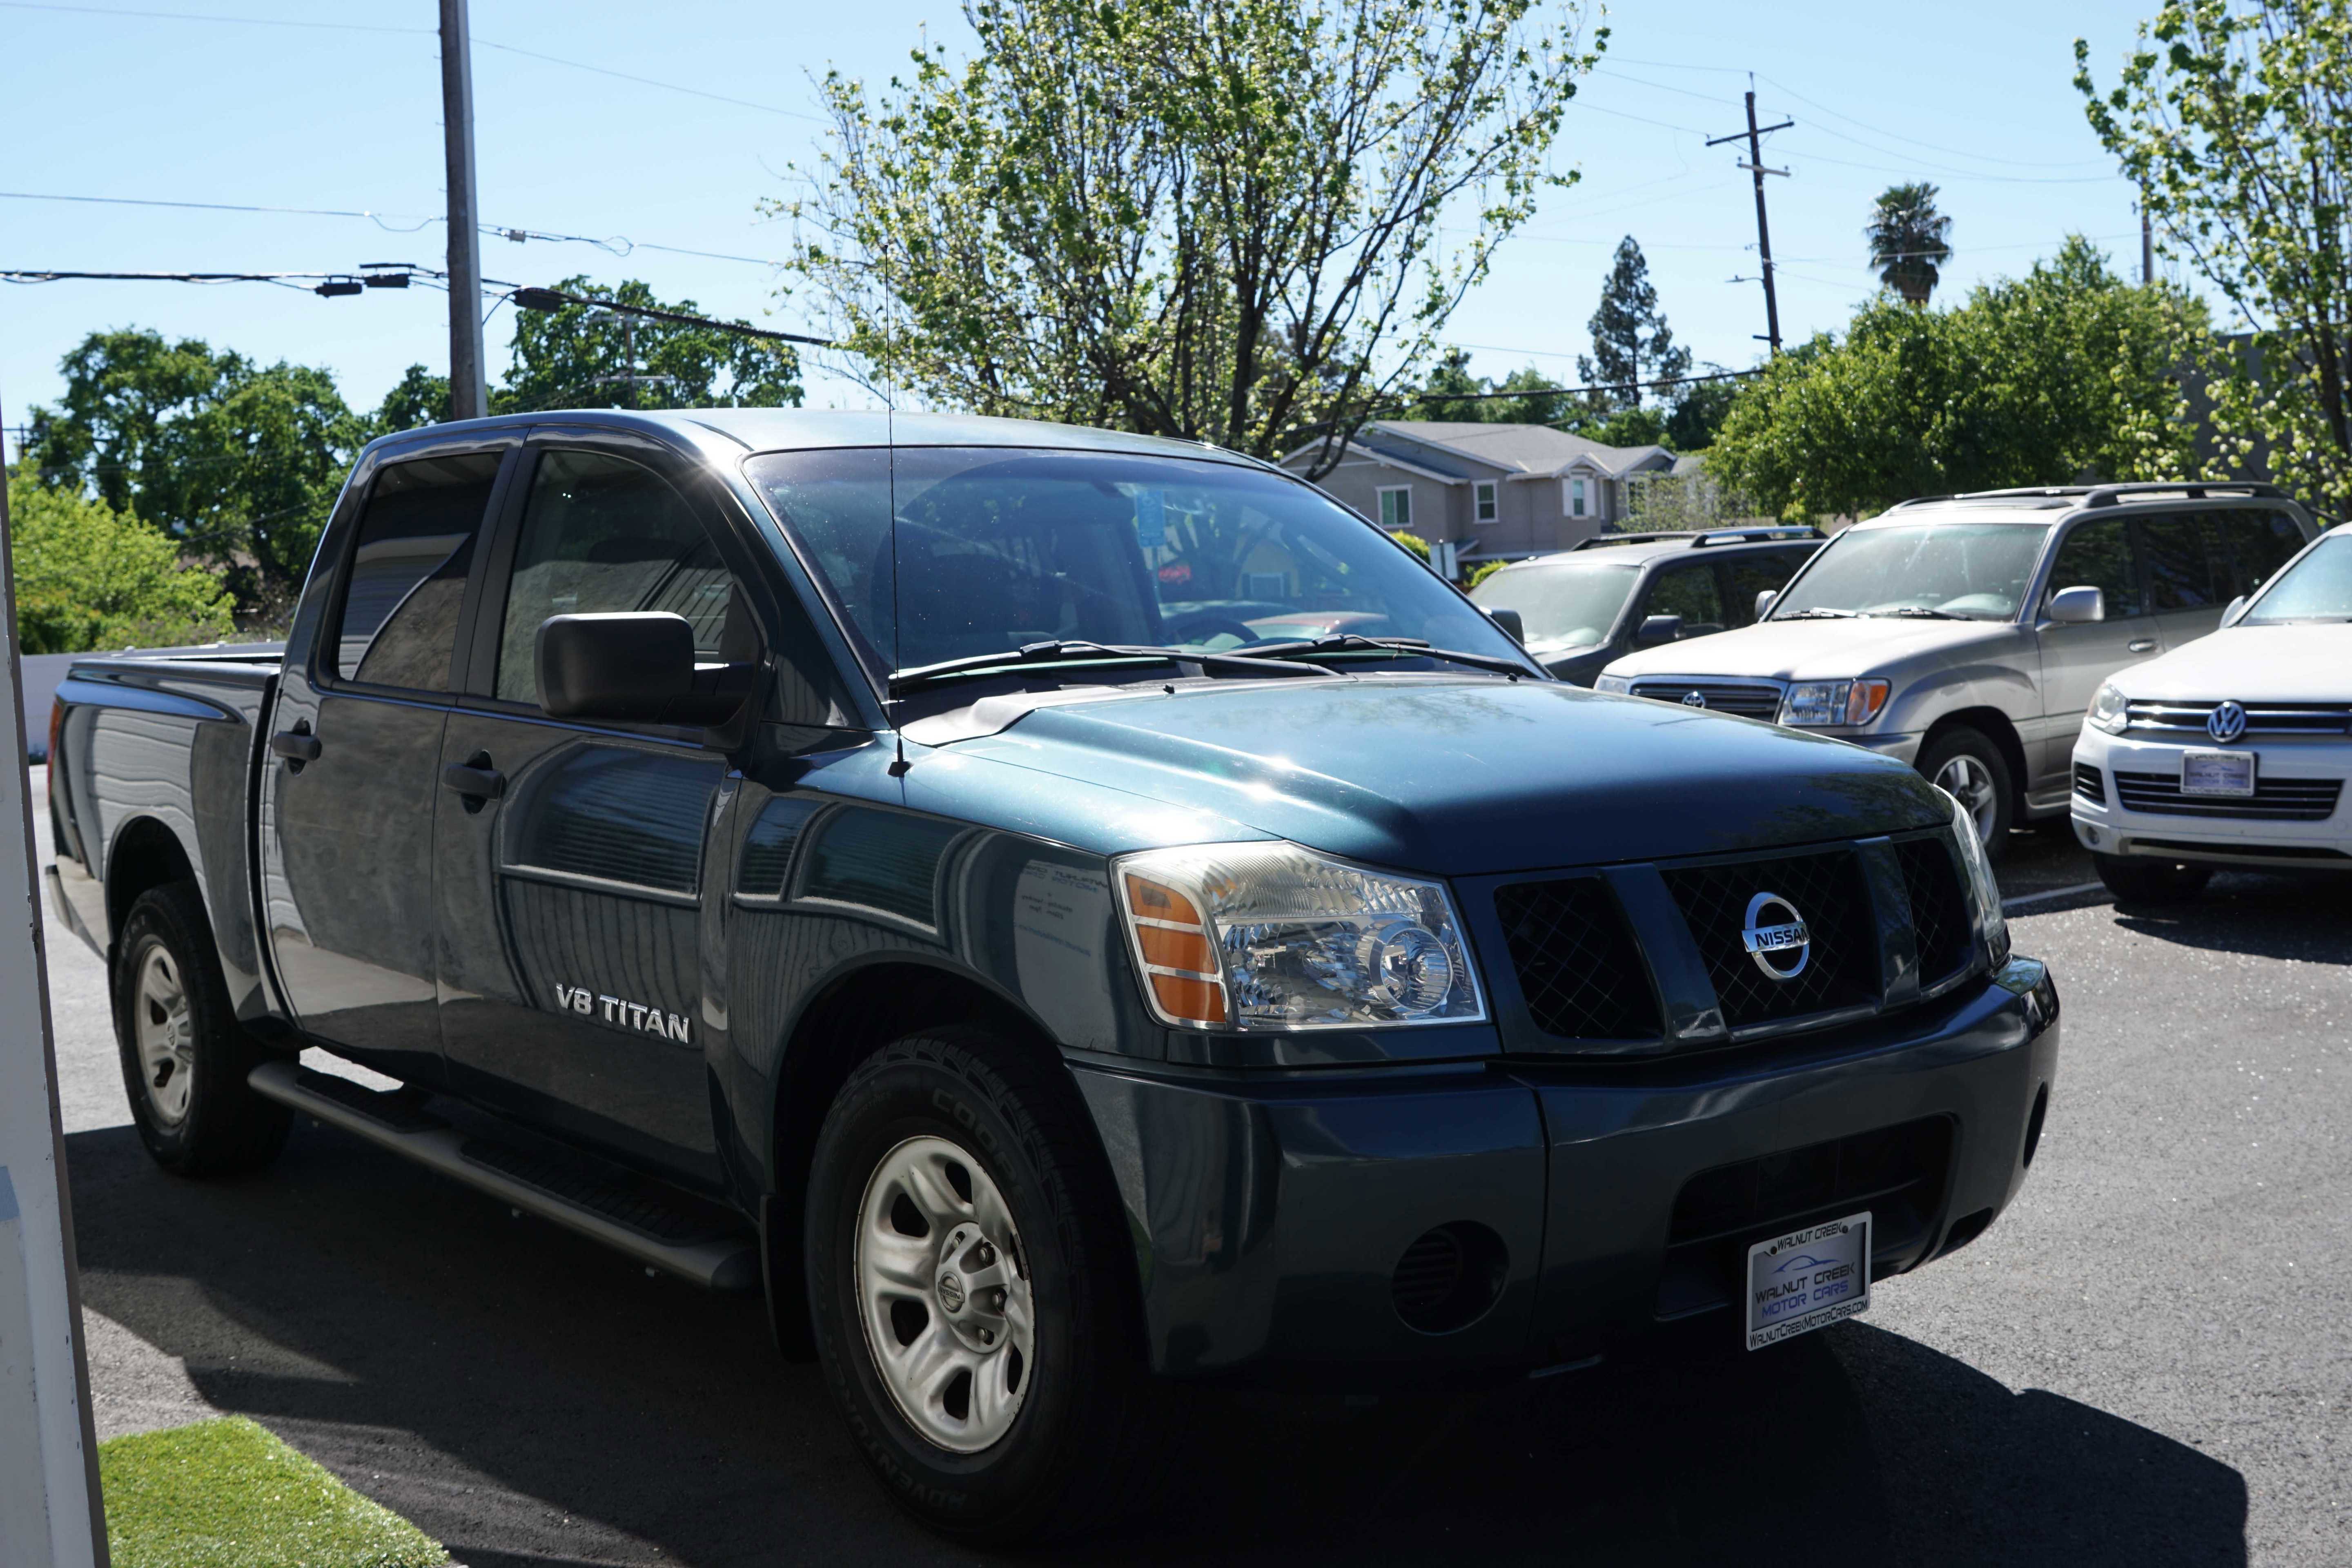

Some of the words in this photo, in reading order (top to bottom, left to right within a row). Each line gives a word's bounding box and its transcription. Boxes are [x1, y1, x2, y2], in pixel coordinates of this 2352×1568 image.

[1755, 927, 1809, 947] NISSAN
[556, 982, 591, 1015] V8
[599, 994, 689, 1044] TITAN
[1777, 1231, 1813, 1250] WALNUT
[1815, 1221, 1843, 1240] CREEK
[1755, 1276, 1808, 1304] WALNUT
[1814, 1262, 1855, 1285] CREEK
[1762, 1293, 1807, 1319] MOTOR
[1813, 1280, 1849, 1301] CARS
